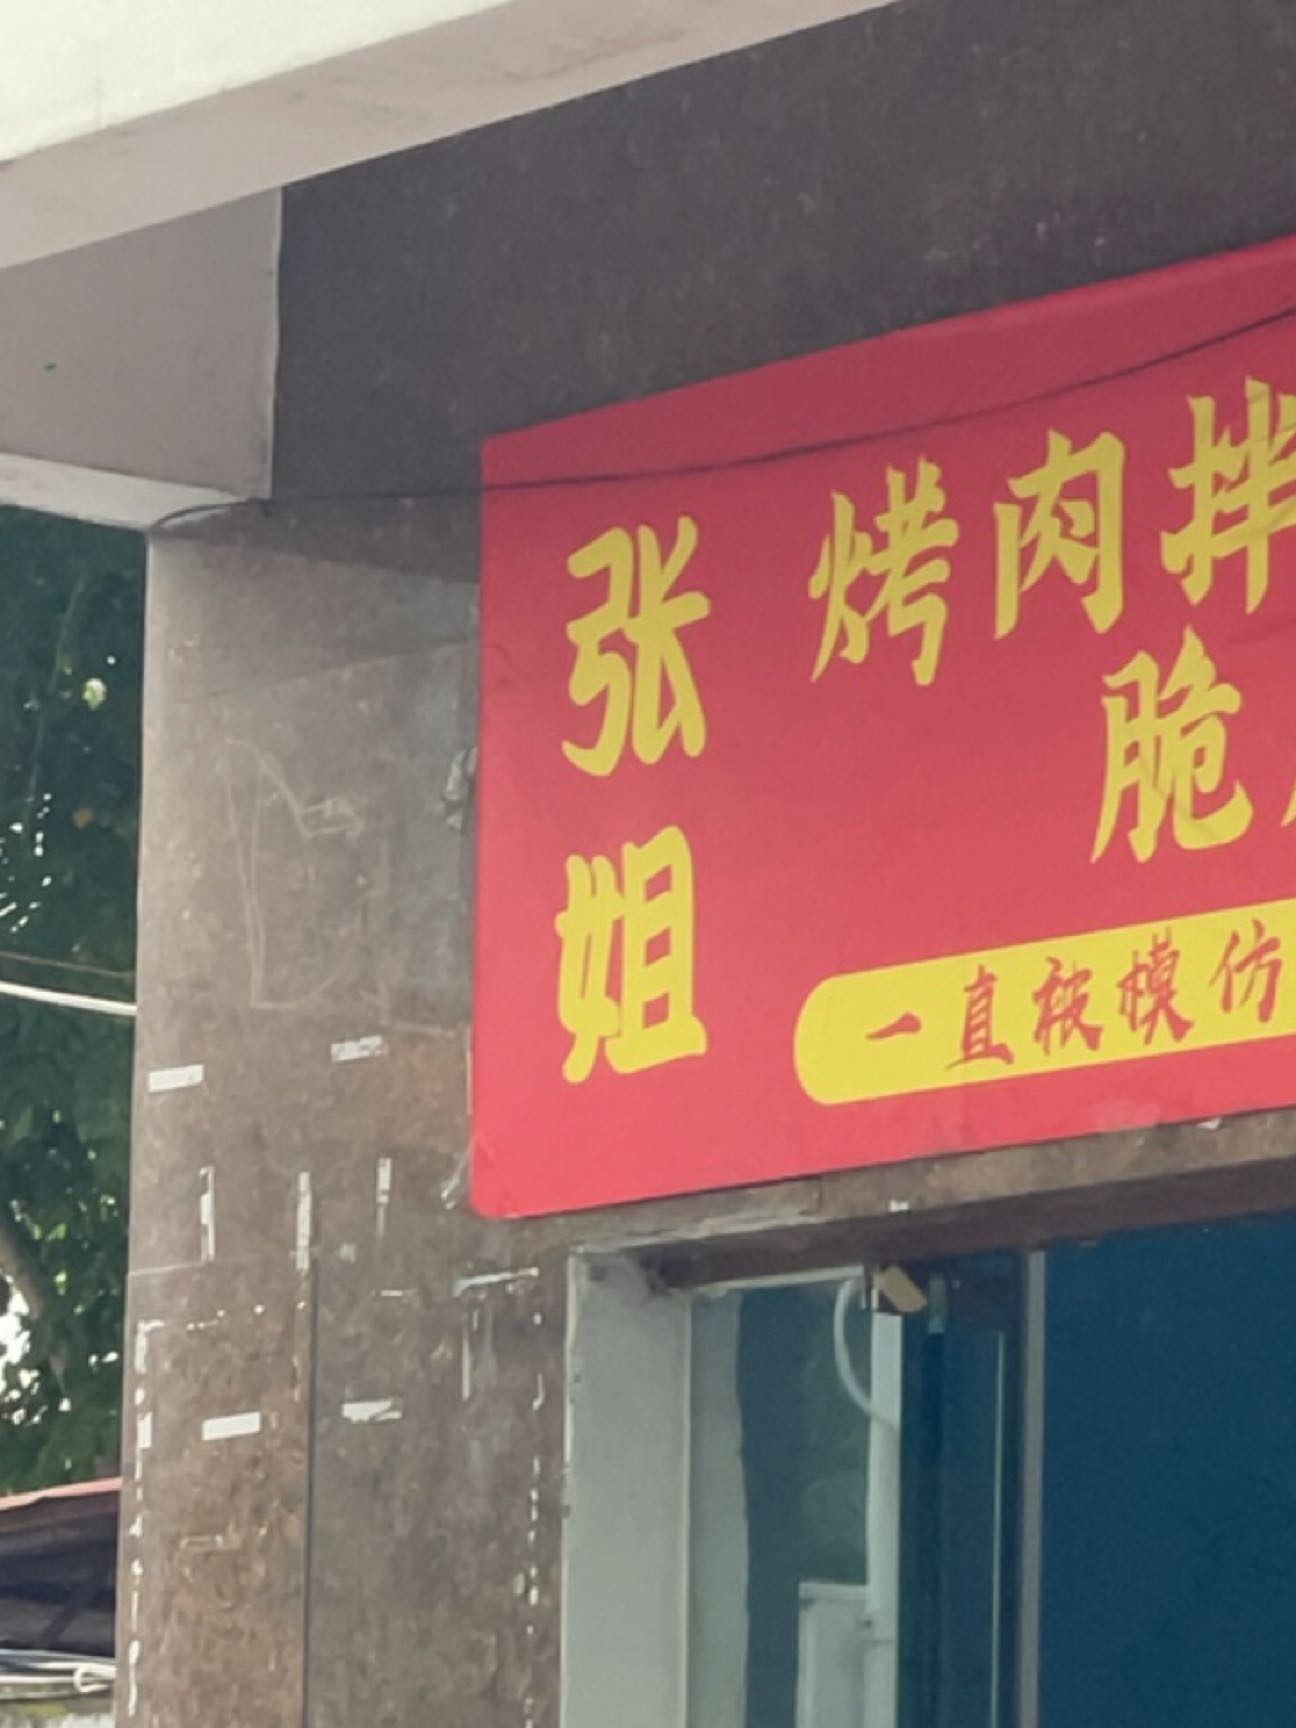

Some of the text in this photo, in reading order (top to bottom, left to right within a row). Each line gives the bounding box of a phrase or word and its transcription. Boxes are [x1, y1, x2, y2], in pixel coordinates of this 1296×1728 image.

[557, 516, 711, 1084] 张姐
[862, 932, 1284, 1072] 一直被模仿
